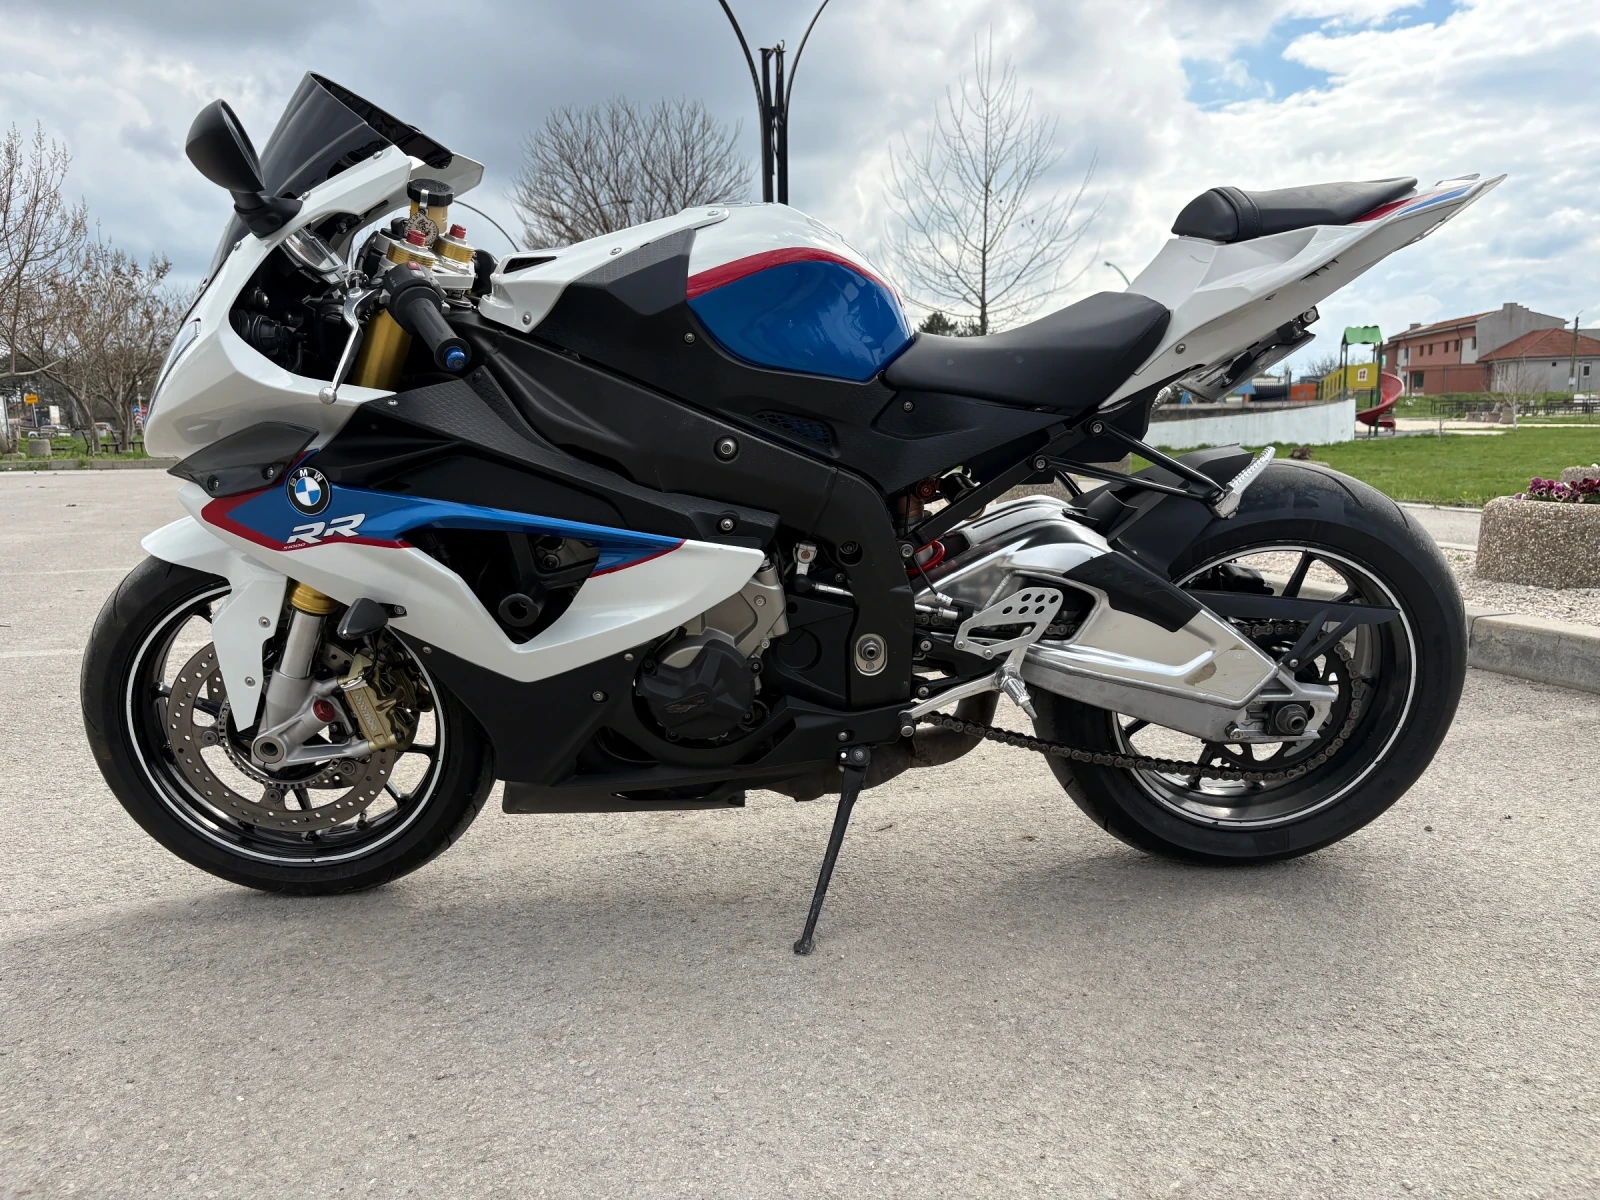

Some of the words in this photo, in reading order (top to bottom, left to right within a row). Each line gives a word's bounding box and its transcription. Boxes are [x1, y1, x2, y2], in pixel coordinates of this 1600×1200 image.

[290, 468, 323, 487] BMW
[286, 513, 366, 544] RR
[355, 694, 377, 732] brembo
